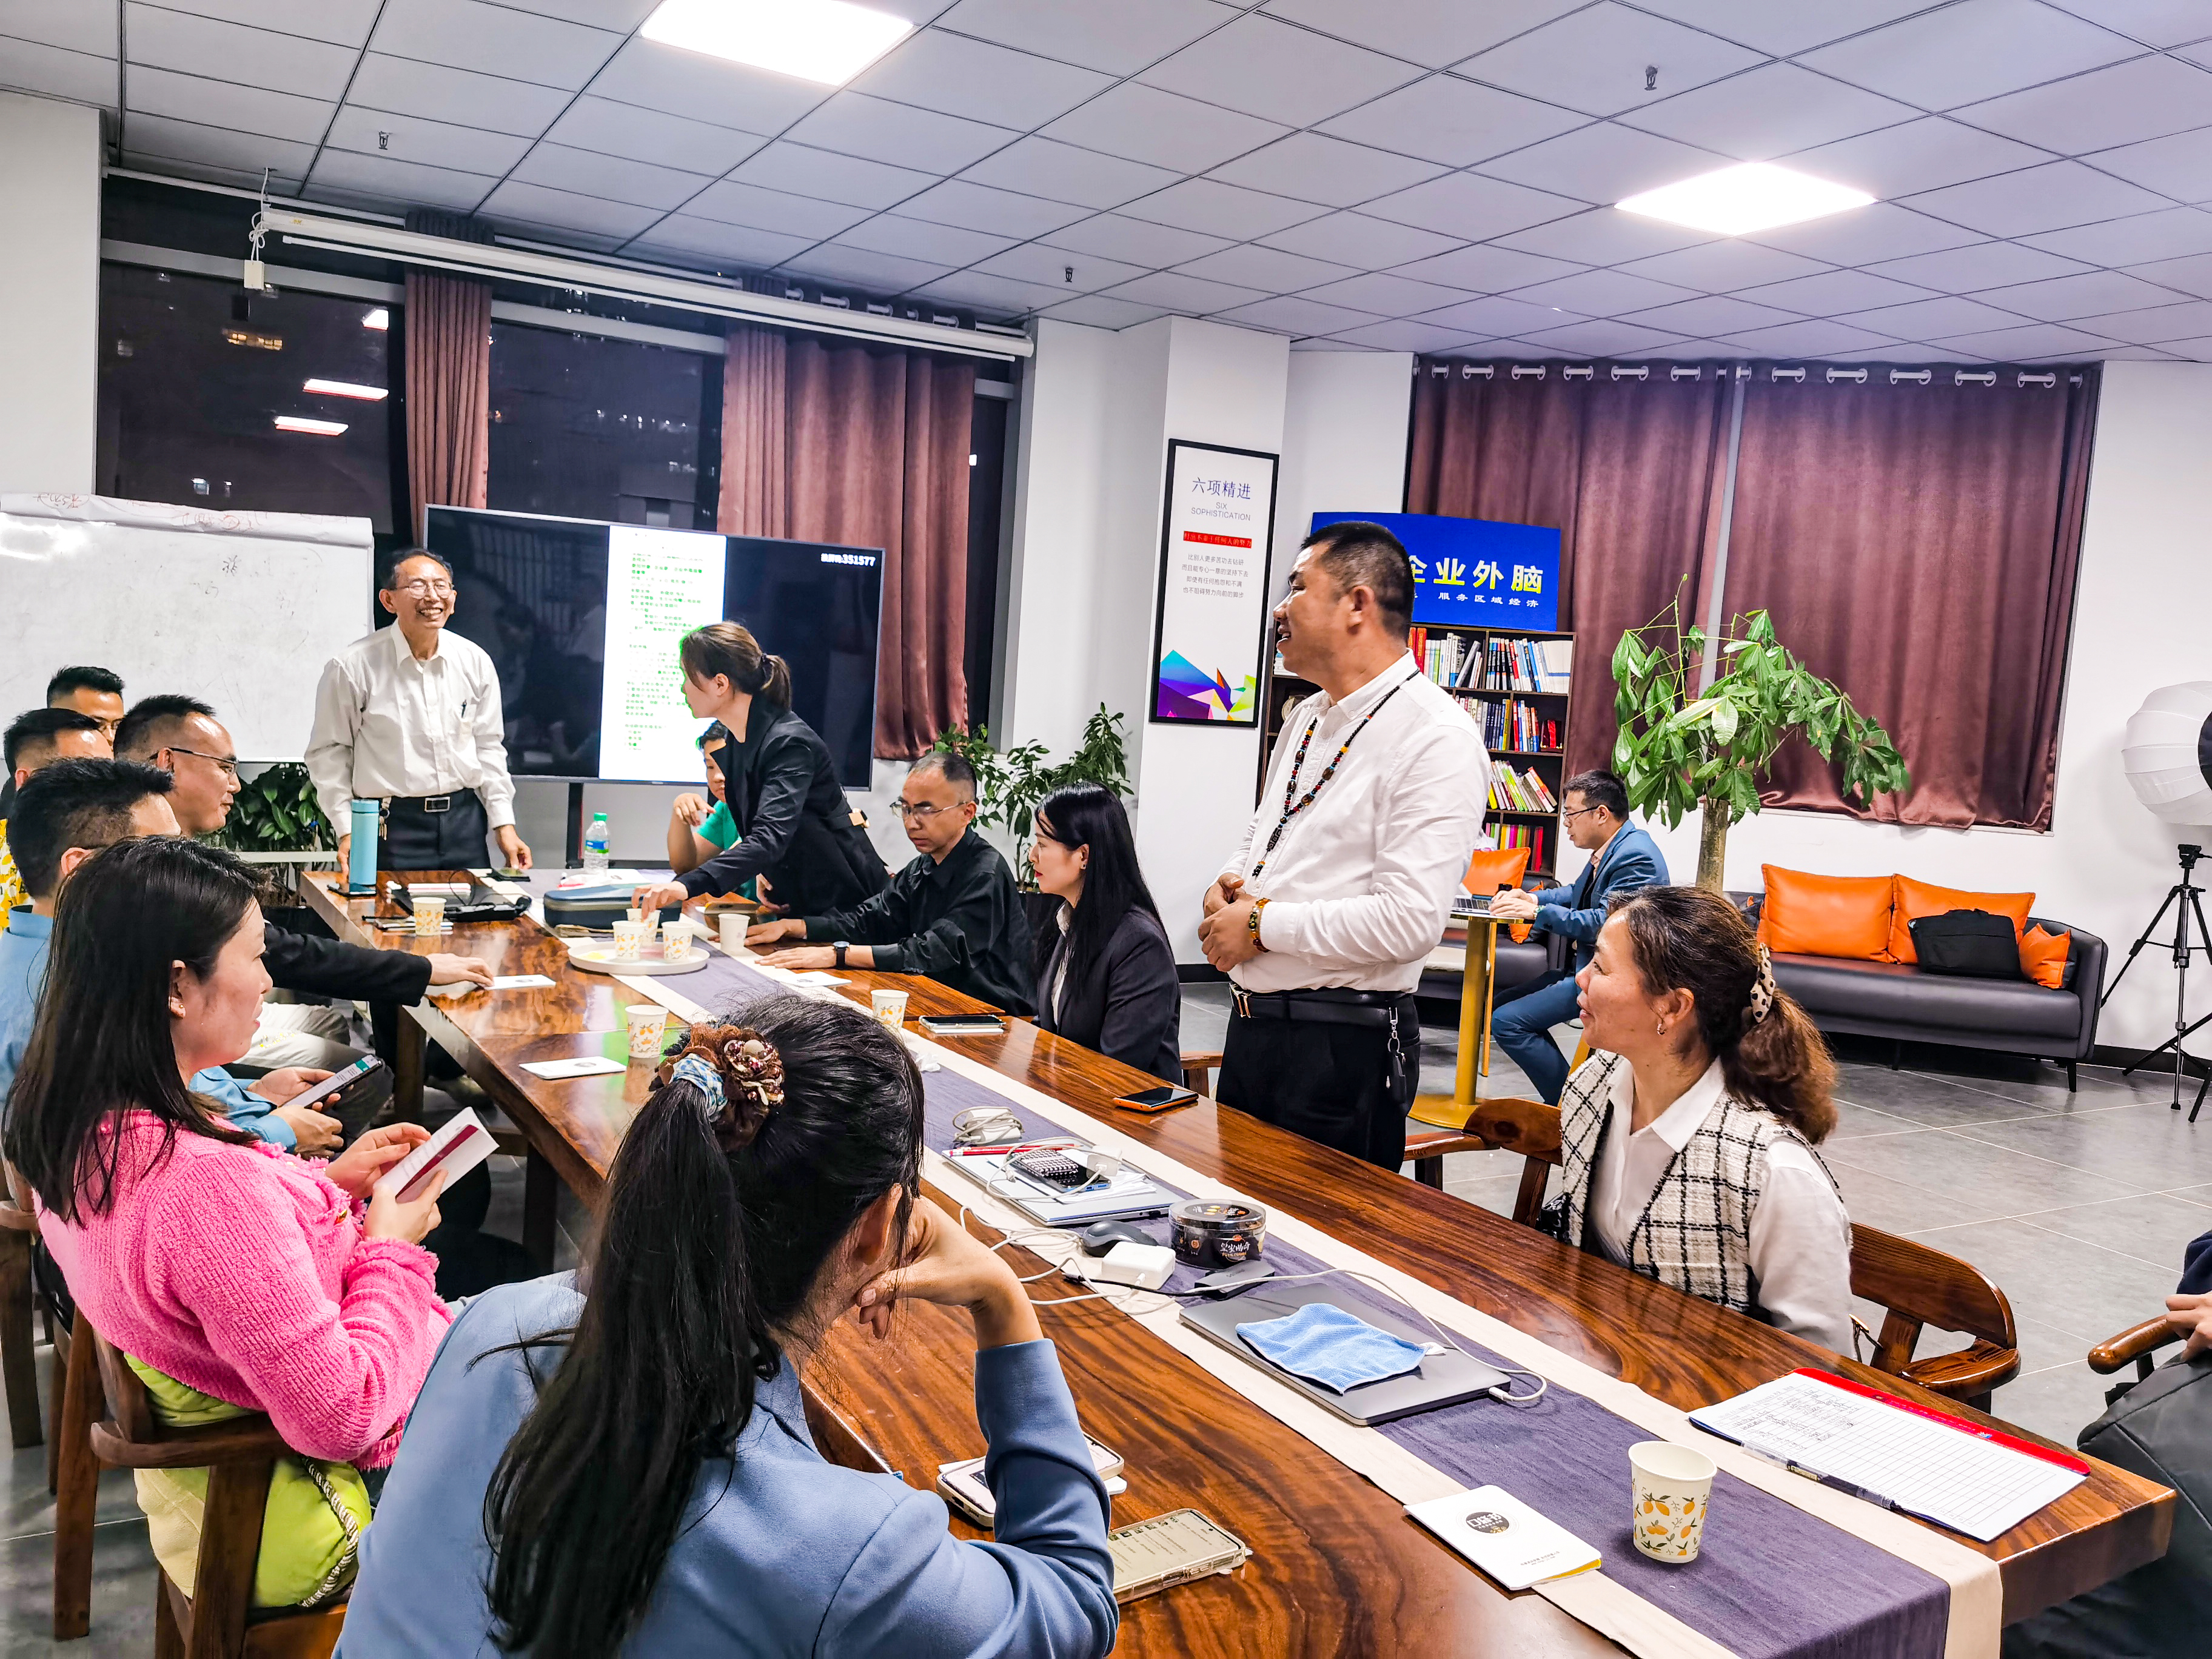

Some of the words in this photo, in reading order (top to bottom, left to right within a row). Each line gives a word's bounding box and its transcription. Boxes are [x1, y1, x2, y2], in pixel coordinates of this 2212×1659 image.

[1191, 477, 1250, 499] 六项精进
[1191, 508, 1250, 521] SOPHISTICATION
[1438, 592, 1539, 608] 服务区域经济
